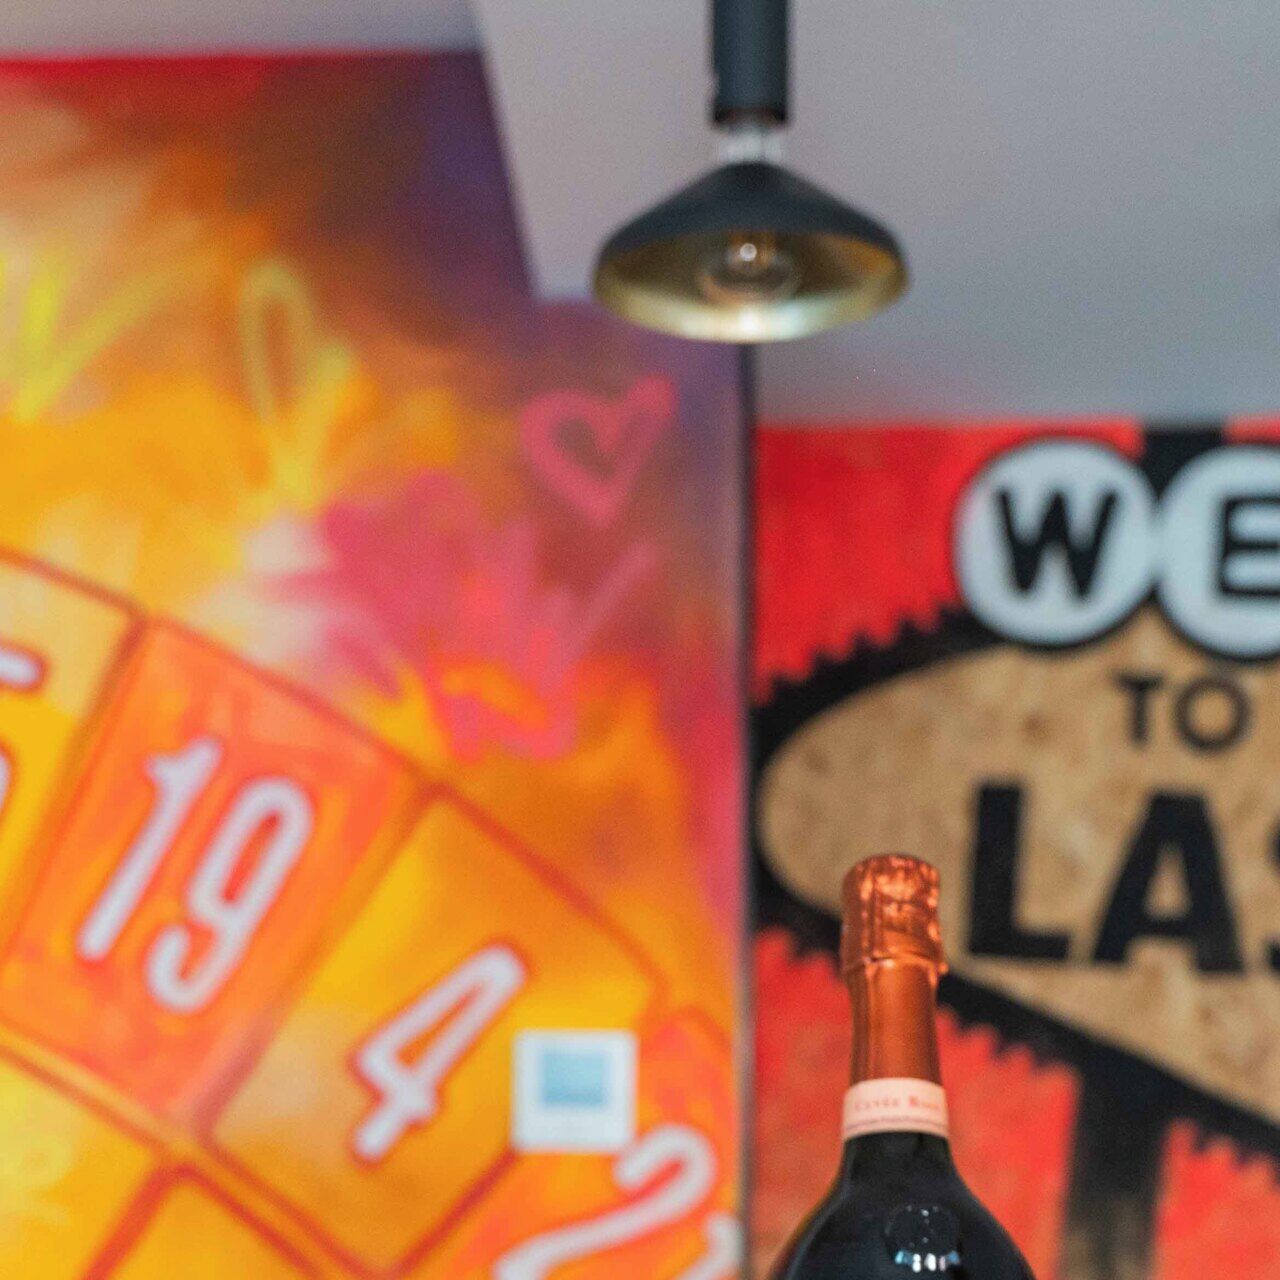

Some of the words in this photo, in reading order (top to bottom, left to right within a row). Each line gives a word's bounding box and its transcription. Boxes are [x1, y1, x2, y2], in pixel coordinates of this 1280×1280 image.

[1114, 670, 1250, 756] TO
[75, 738, 315, 1014] 19
[350, 945, 526, 1162] 4
